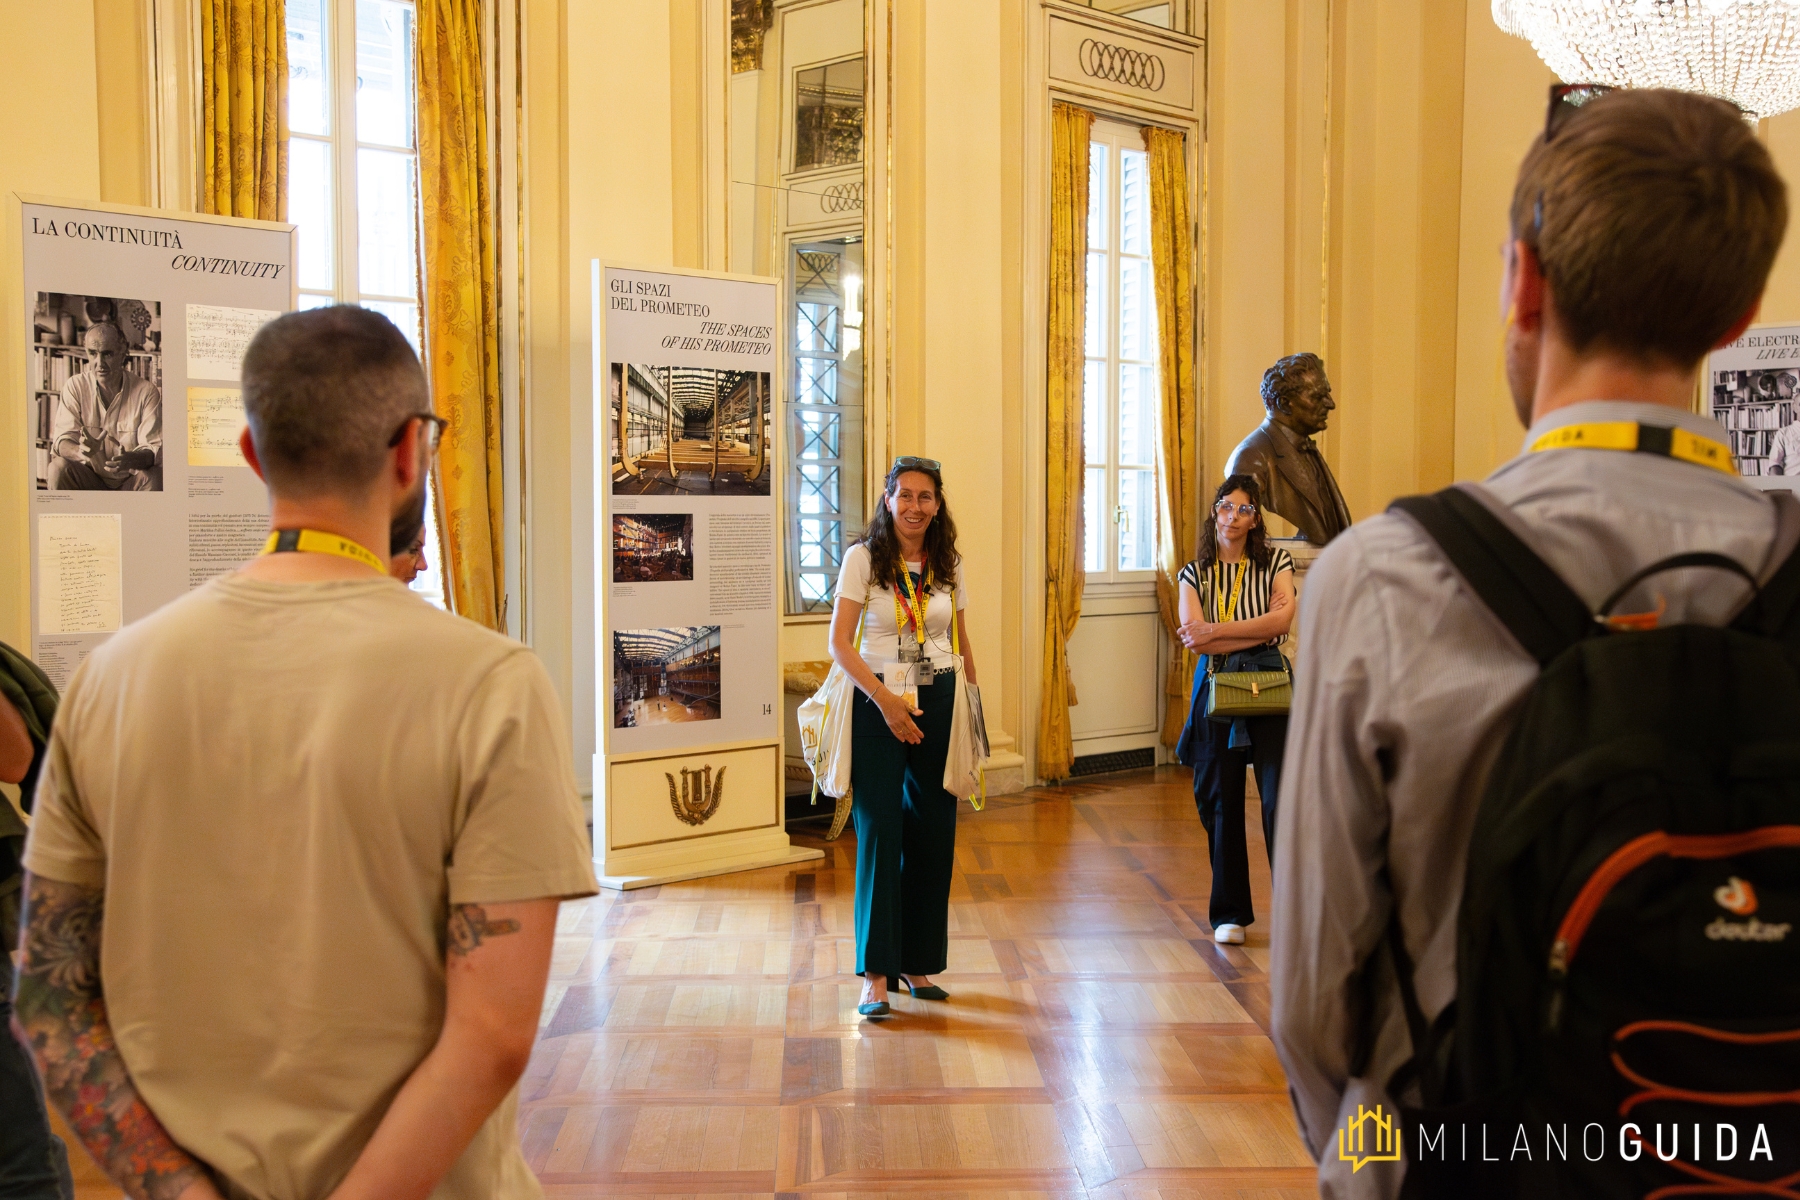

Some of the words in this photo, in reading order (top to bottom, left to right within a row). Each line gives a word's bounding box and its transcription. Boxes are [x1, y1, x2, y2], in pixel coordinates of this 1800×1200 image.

[32, 217, 60, 237] LA
[64, 222, 184, 250] CONTINUITÀ
[171, 254, 285, 279] CONTINUITY
[610, 279, 633, 294] GLI
[636, 281, 671, 298] SPAZI
[611, 296, 638, 312] DEL
[640, 299, 710, 318] PROMETEO
[699, 321, 727, 336] THE
[726, 324, 773, 339] SPACES
[661, 335, 681, 349] OF
[680, 337, 704, 351] HIS
[703, 339, 772, 355] PROMETEO
[1747, 334, 1799, 348] ELECTR
[1755, 347, 1790, 360] LIVE
[762, 703, 772, 716] 14
